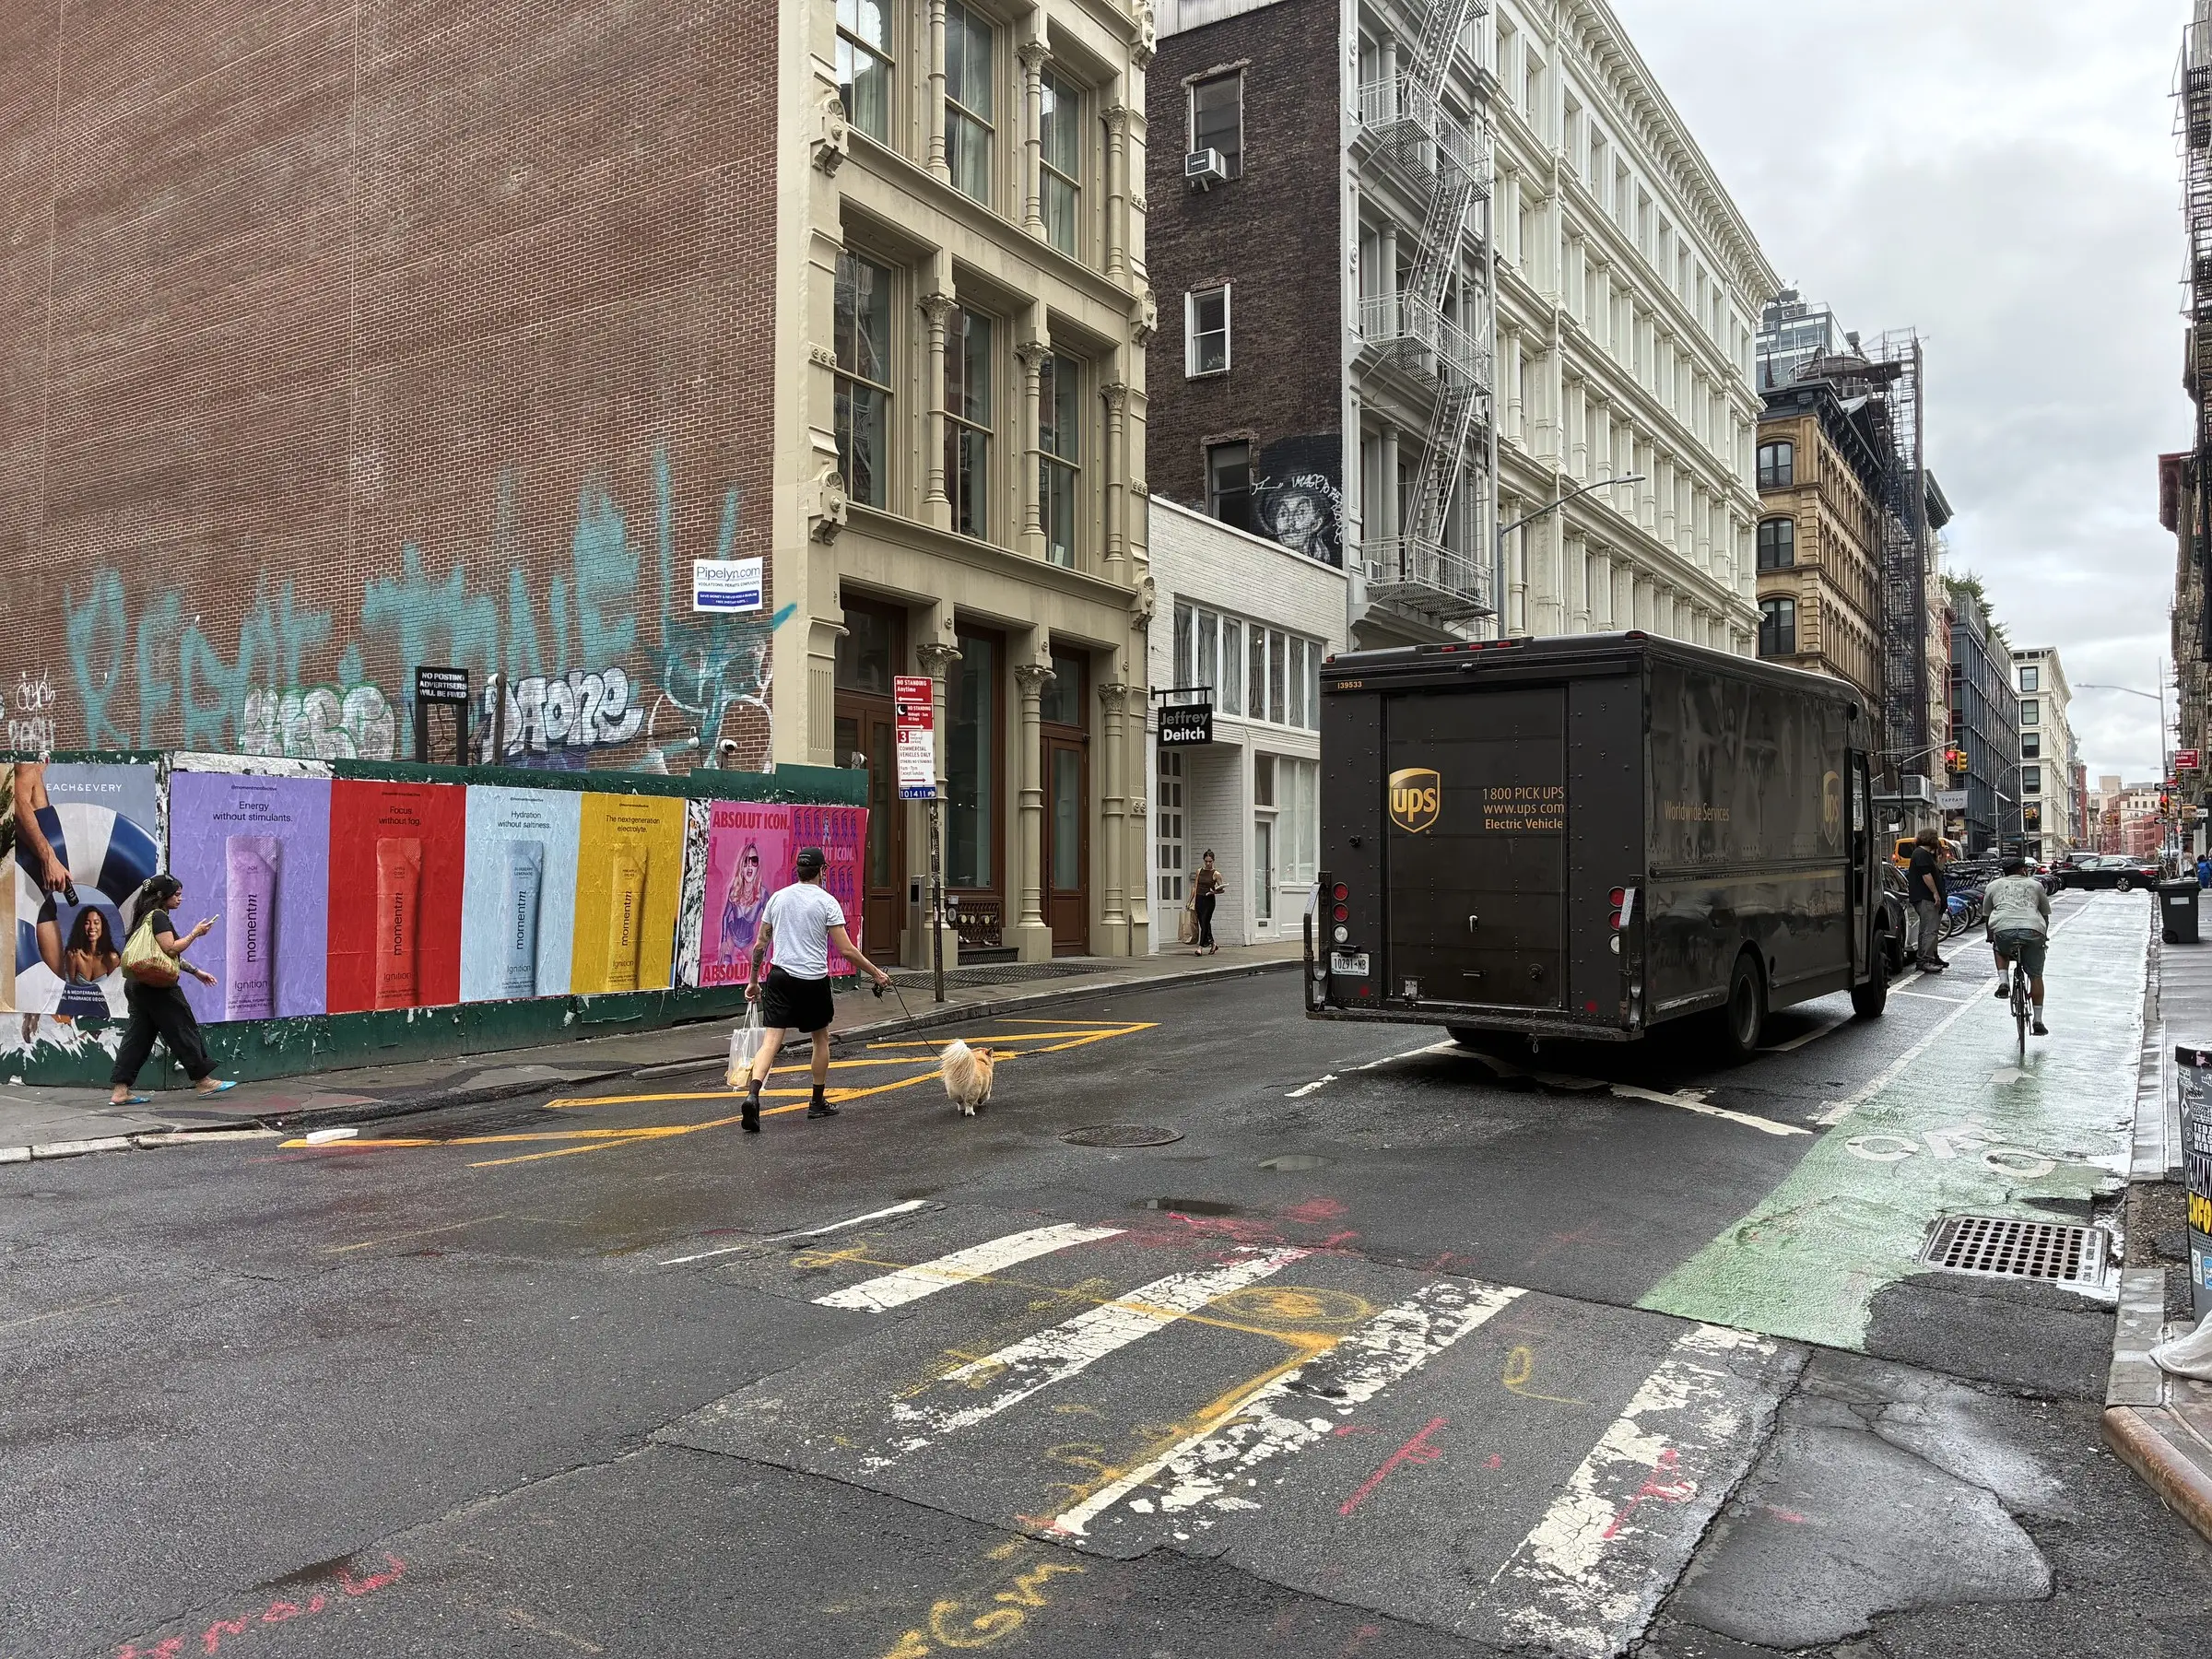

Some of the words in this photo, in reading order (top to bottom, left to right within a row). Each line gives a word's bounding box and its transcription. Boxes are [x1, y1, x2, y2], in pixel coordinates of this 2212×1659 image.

[433, 673, 465, 682] POSTING
[419, 681, 467, 690] ADVERTISERS
[1337, 680, 1362, 689] 139533
[1159, 711, 1209, 725] Jeffrey
[900, 731, 907, 743] 3
[1163, 726, 1206, 742] Deitch
[1514, 786, 1540, 799] PICK
[1543, 786, 1564, 799] UPS
[239, 800, 270, 812] Energy
[389, 806, 413, 815] Focus
[1393, 788, 1436, 823] ups
[1664, 799, 1702, 821] Worldwide
[1702, 802, 1730, 822] Services
[212, 812, 246, 821] without
[248, 813, 293, 822] stimulants.
[511, 810, 542, 819] Hydration
[606, 814, 618, 823] The
[712, 810, 763, 830] ABSOLUT
[763, 812, 790, 830] ICON.
[378, 817, 406, 825] without
[407, 817, 422, 827] fog.
[523, 821, 552, 830] saltiness.
[1485, 818, 1523, 830] Electric
[1524, 818, 1563, 829] Vehicle
[834, 846, 855, 861] ICON.
[394, 891, 404, 956] momentm
[516, 890, 527, 950] momentm
[621, 890, 632, 947] momentm
[246, 893, 258, 963] momentm
[507, 964, 532, 975] Ignition
[612, 959, 635, 970] Ignition
[383, 971, 412, 982] Ignition
[234, 980, 269, 992] Ignition
